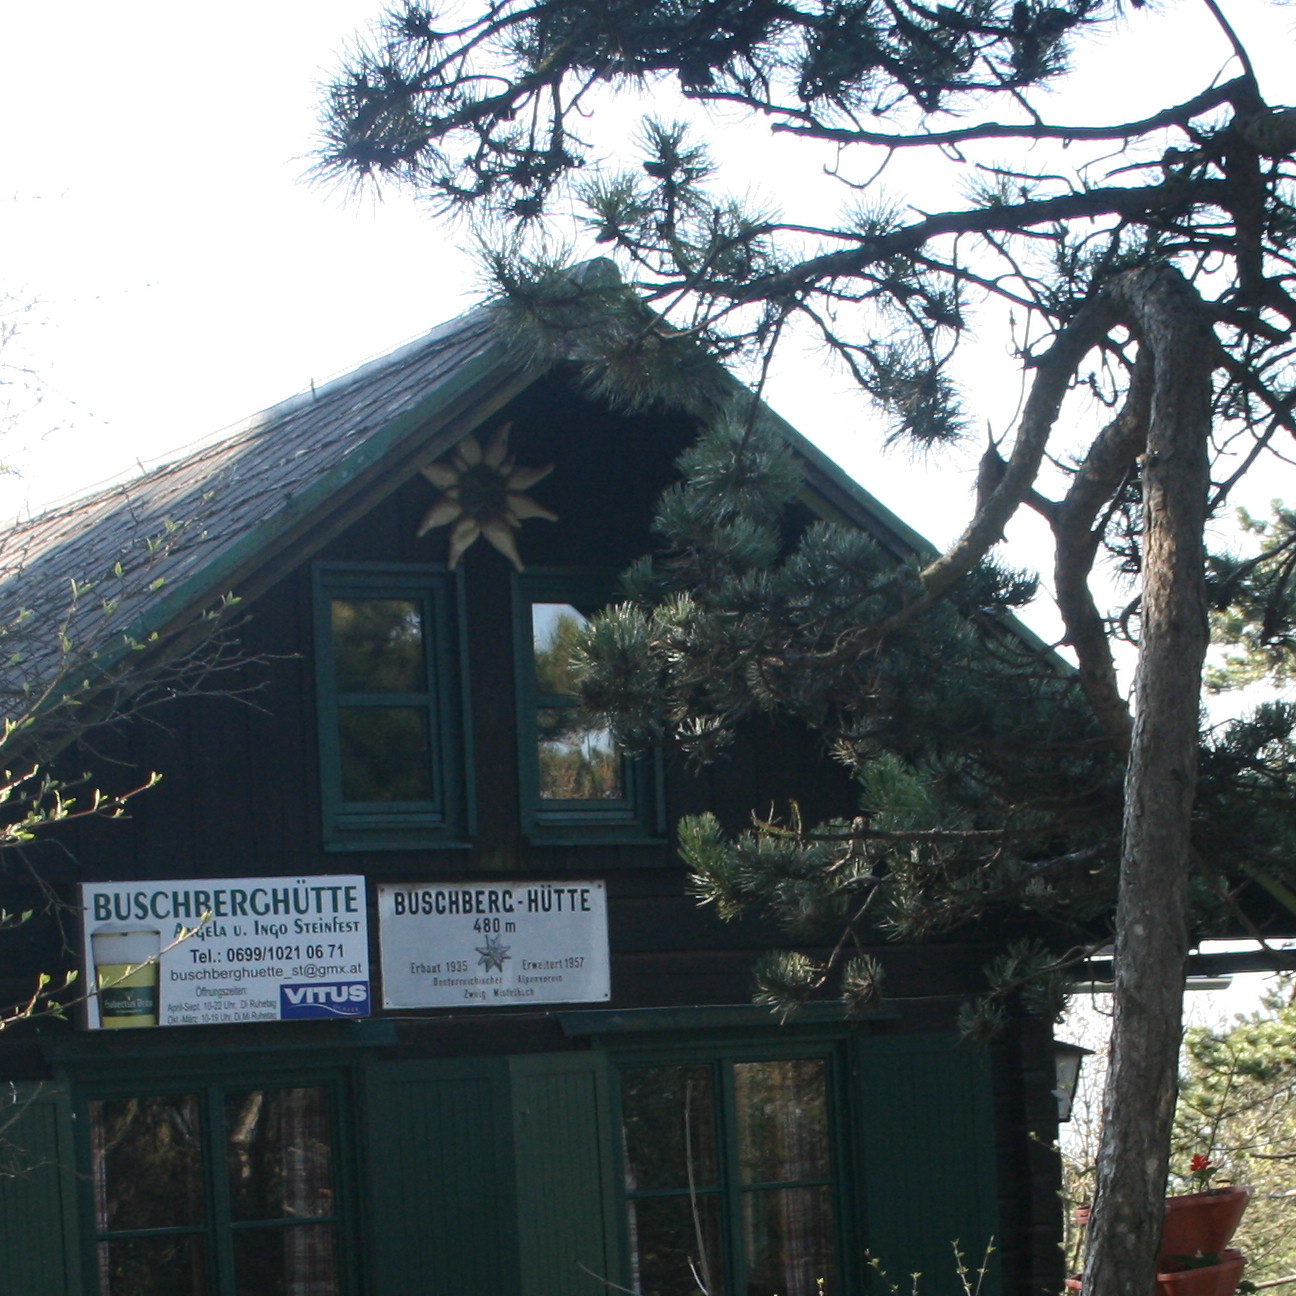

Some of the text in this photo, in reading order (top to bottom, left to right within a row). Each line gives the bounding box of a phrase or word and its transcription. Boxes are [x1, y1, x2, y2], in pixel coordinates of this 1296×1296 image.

[93, 880, 359, 921] BUSCHBERGHÜTTE
[473, 917, 516, 933] 480 m
[190, 944, 344, 964] Tel.: 0699/1021 06 71
[170, 963, 362, 981] buschberghuette_st@gmx.at
[410, 960, 468, 974] Erbaut 1935
[522, 959, 562, 971] Erweitert
[284, 984, 367, 1004] VITUS
